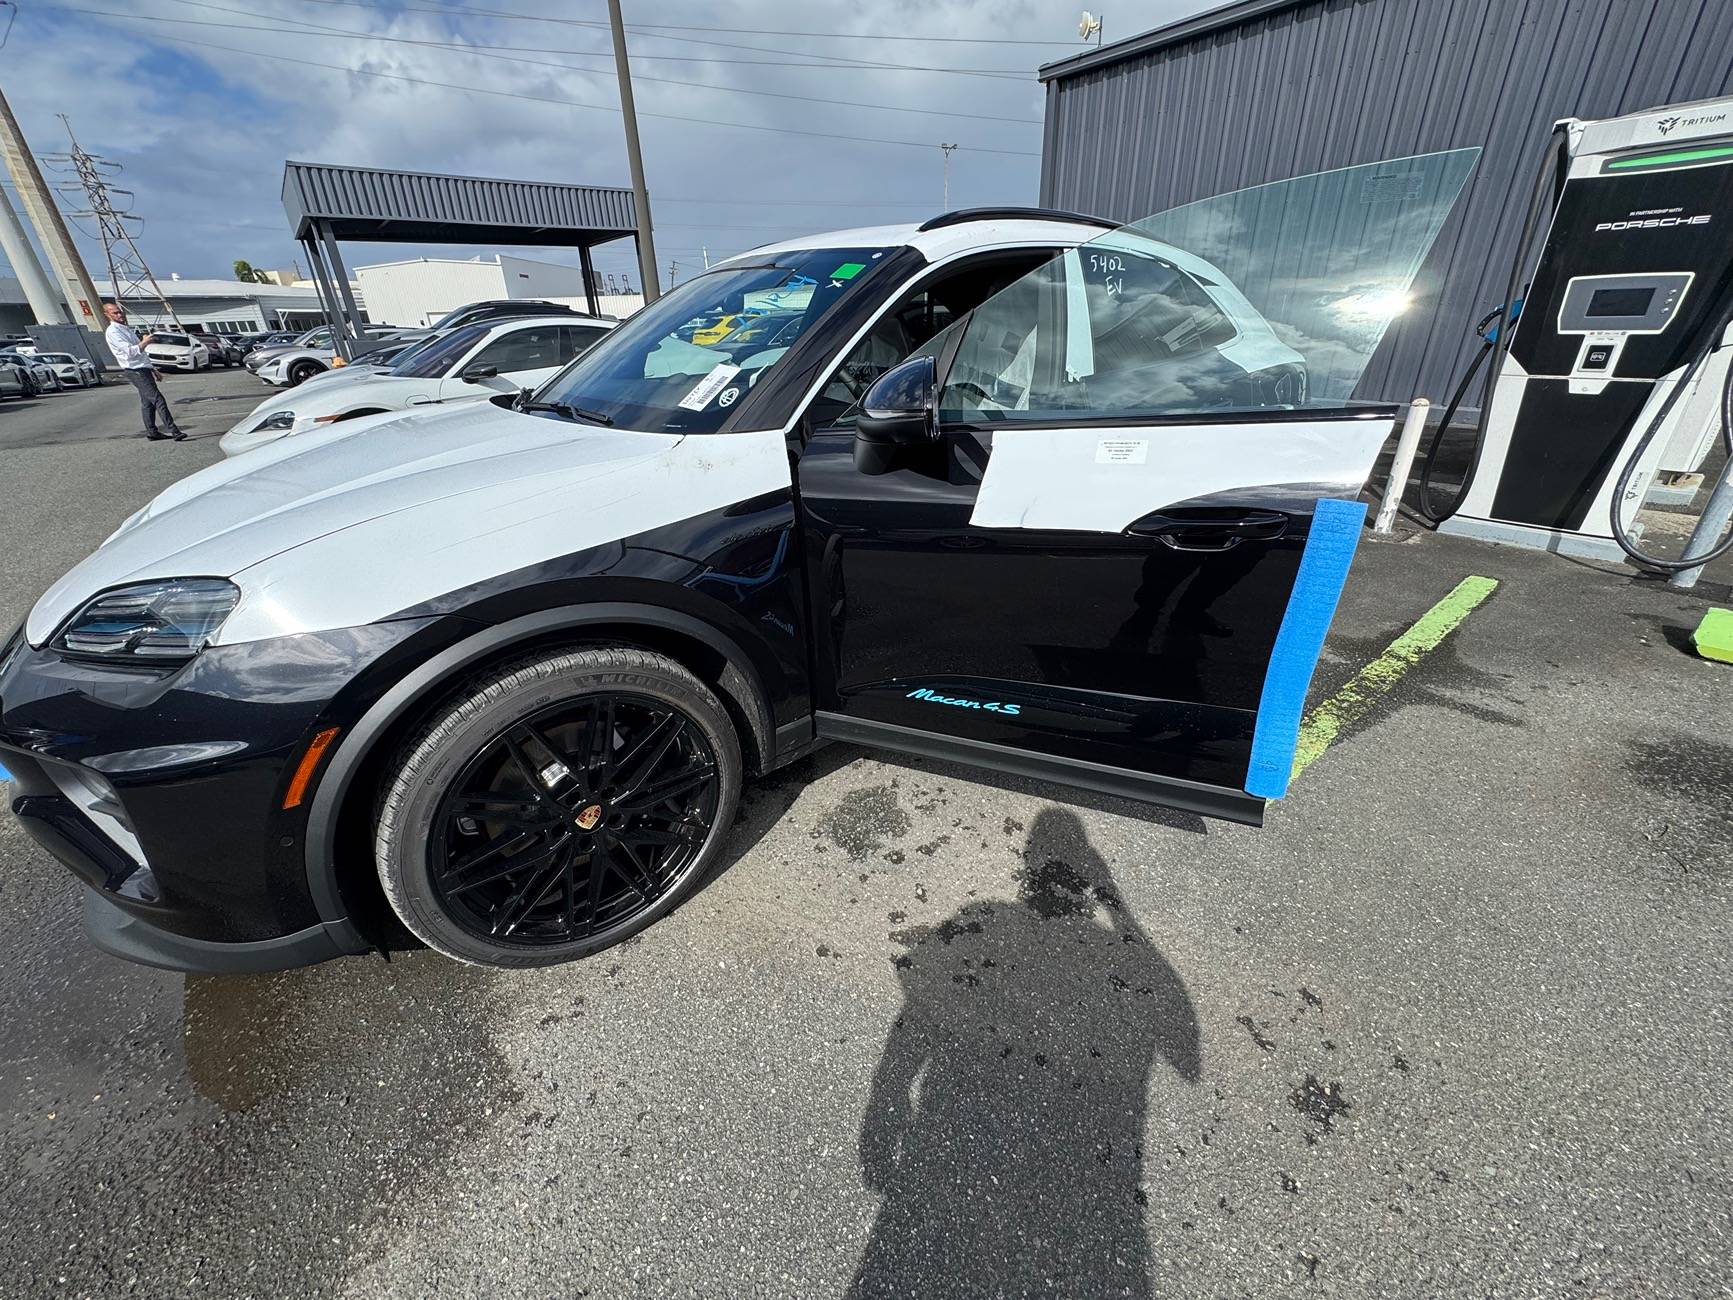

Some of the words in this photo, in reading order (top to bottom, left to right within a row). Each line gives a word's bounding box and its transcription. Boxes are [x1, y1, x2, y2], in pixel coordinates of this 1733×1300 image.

[1681, 113, 1727, 128] TRITIUM
[1595, 214, 1712, 232] PORSCHE
[1090, 254, 1126, 273] 5402
[1105, 275, 1123, 296] EV
[905, 688, 981, 709] Macan
[983, 702, 1021, 715] 4S
